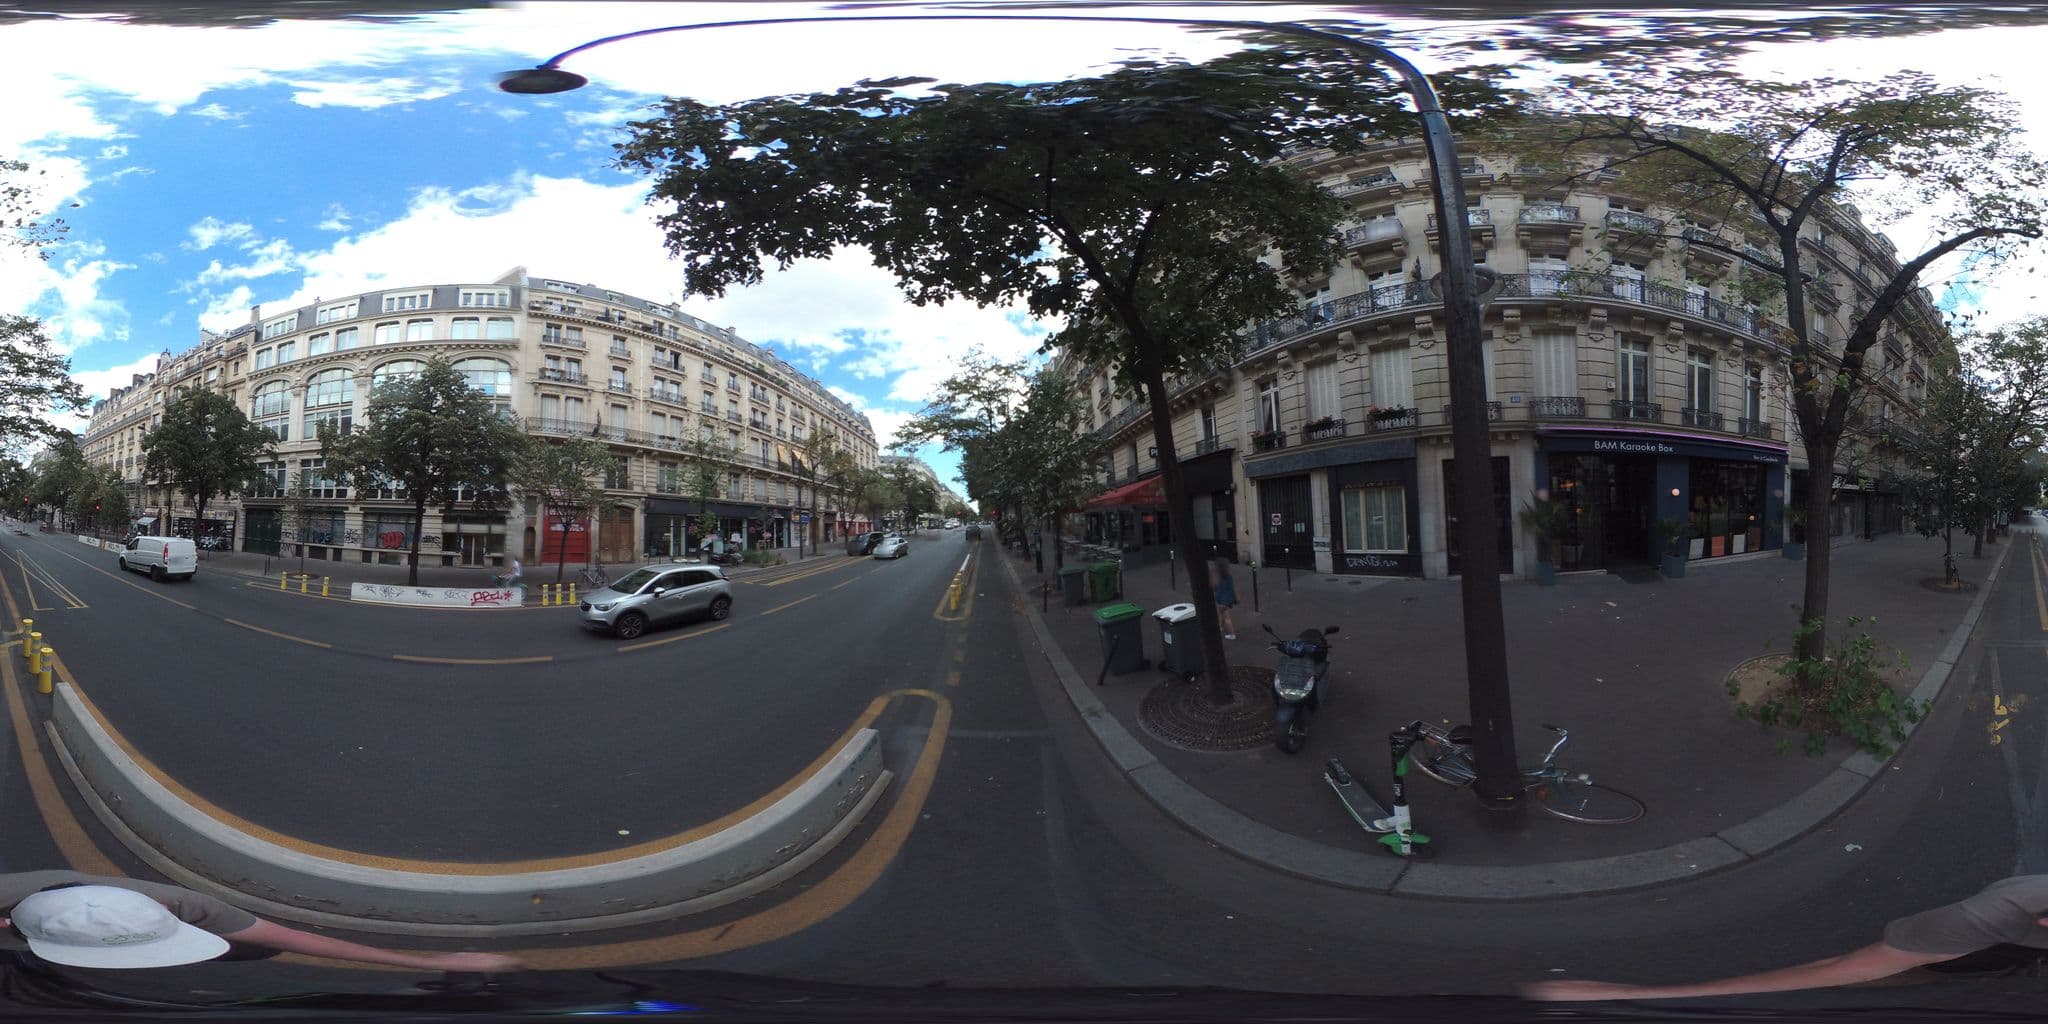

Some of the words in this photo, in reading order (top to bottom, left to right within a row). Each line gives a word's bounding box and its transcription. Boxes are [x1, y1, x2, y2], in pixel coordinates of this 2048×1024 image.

[1594, 440, 1617, 450] BAM
[1620, 441, 1656, 452] Karaoke
[1658, 443, 1674, 453] Box
